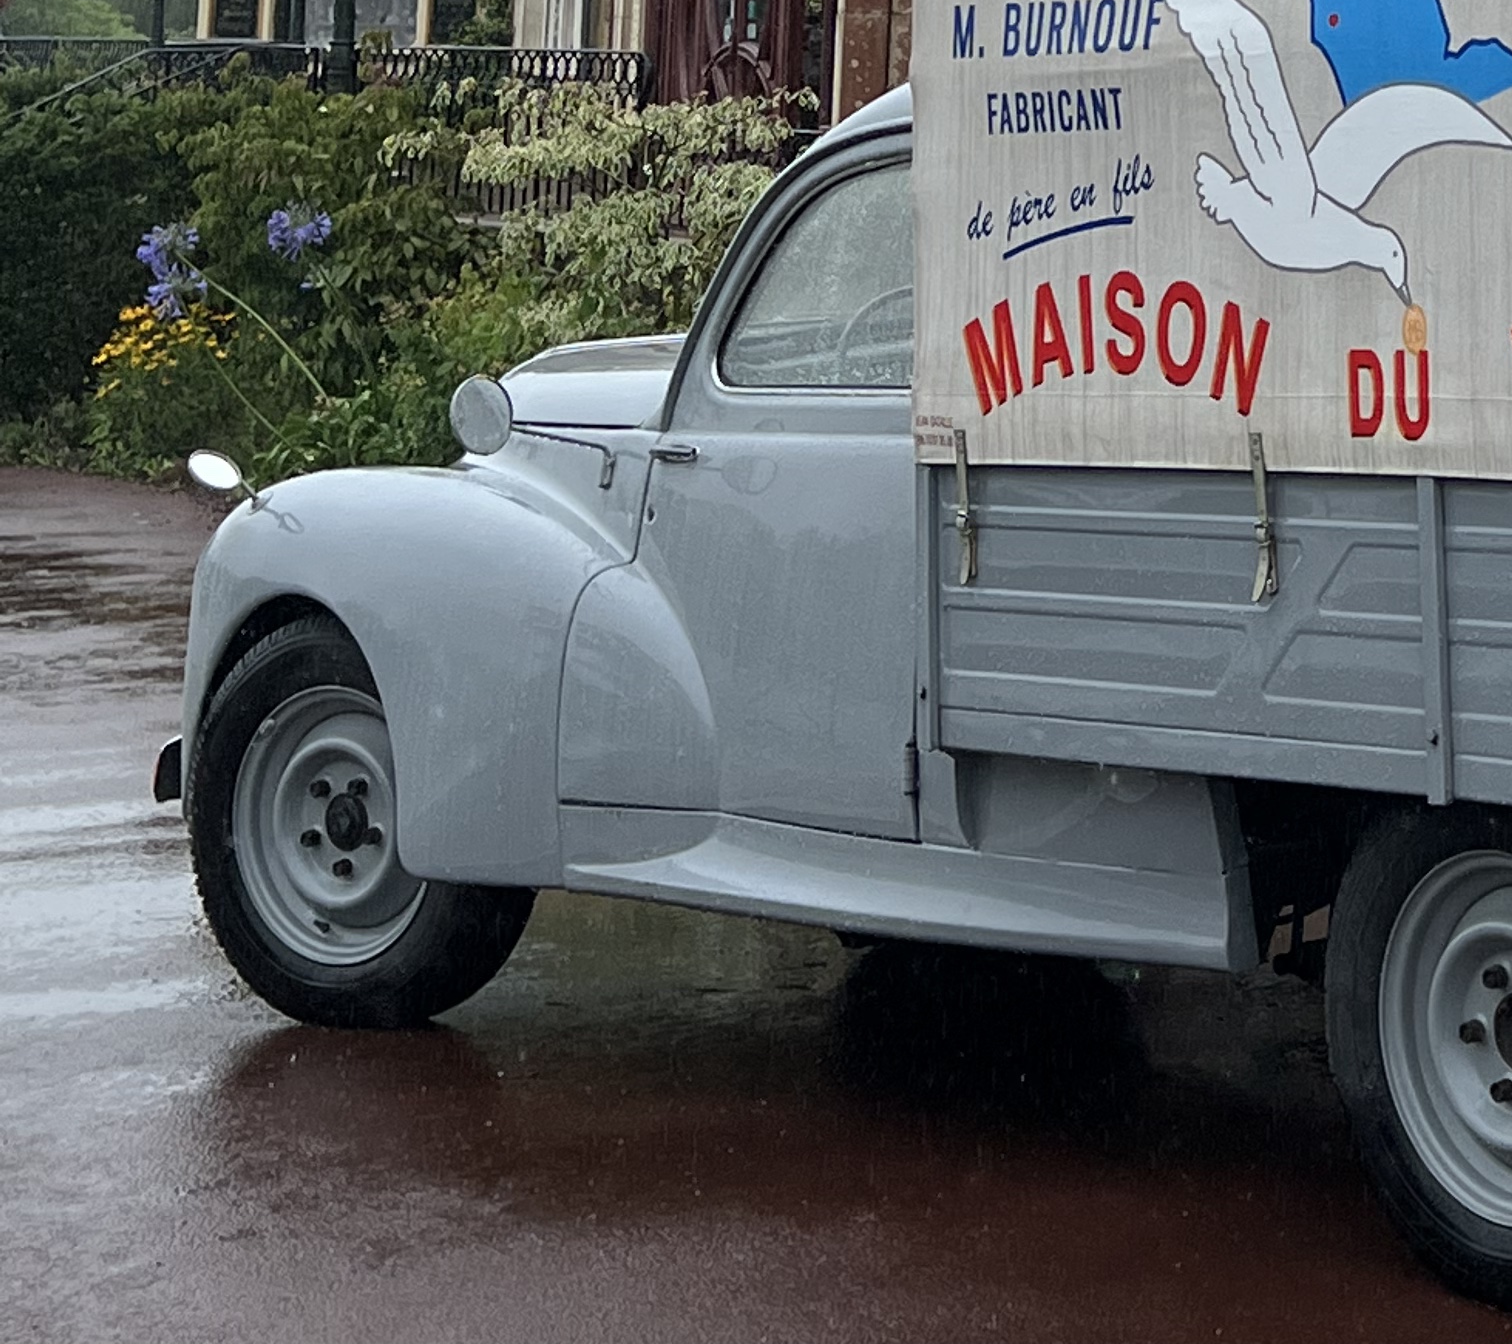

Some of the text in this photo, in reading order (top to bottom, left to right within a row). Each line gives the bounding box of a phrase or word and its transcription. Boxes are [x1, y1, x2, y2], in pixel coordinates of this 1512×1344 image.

[953, 5, 985, 59] M.
[987, 87, 1122, 135] FABRICANT
[967, 153, 1155, 242] de père en fils
[962, 269, 1270, 418] MAISON
[1347, 348, 1430, 441] DU
